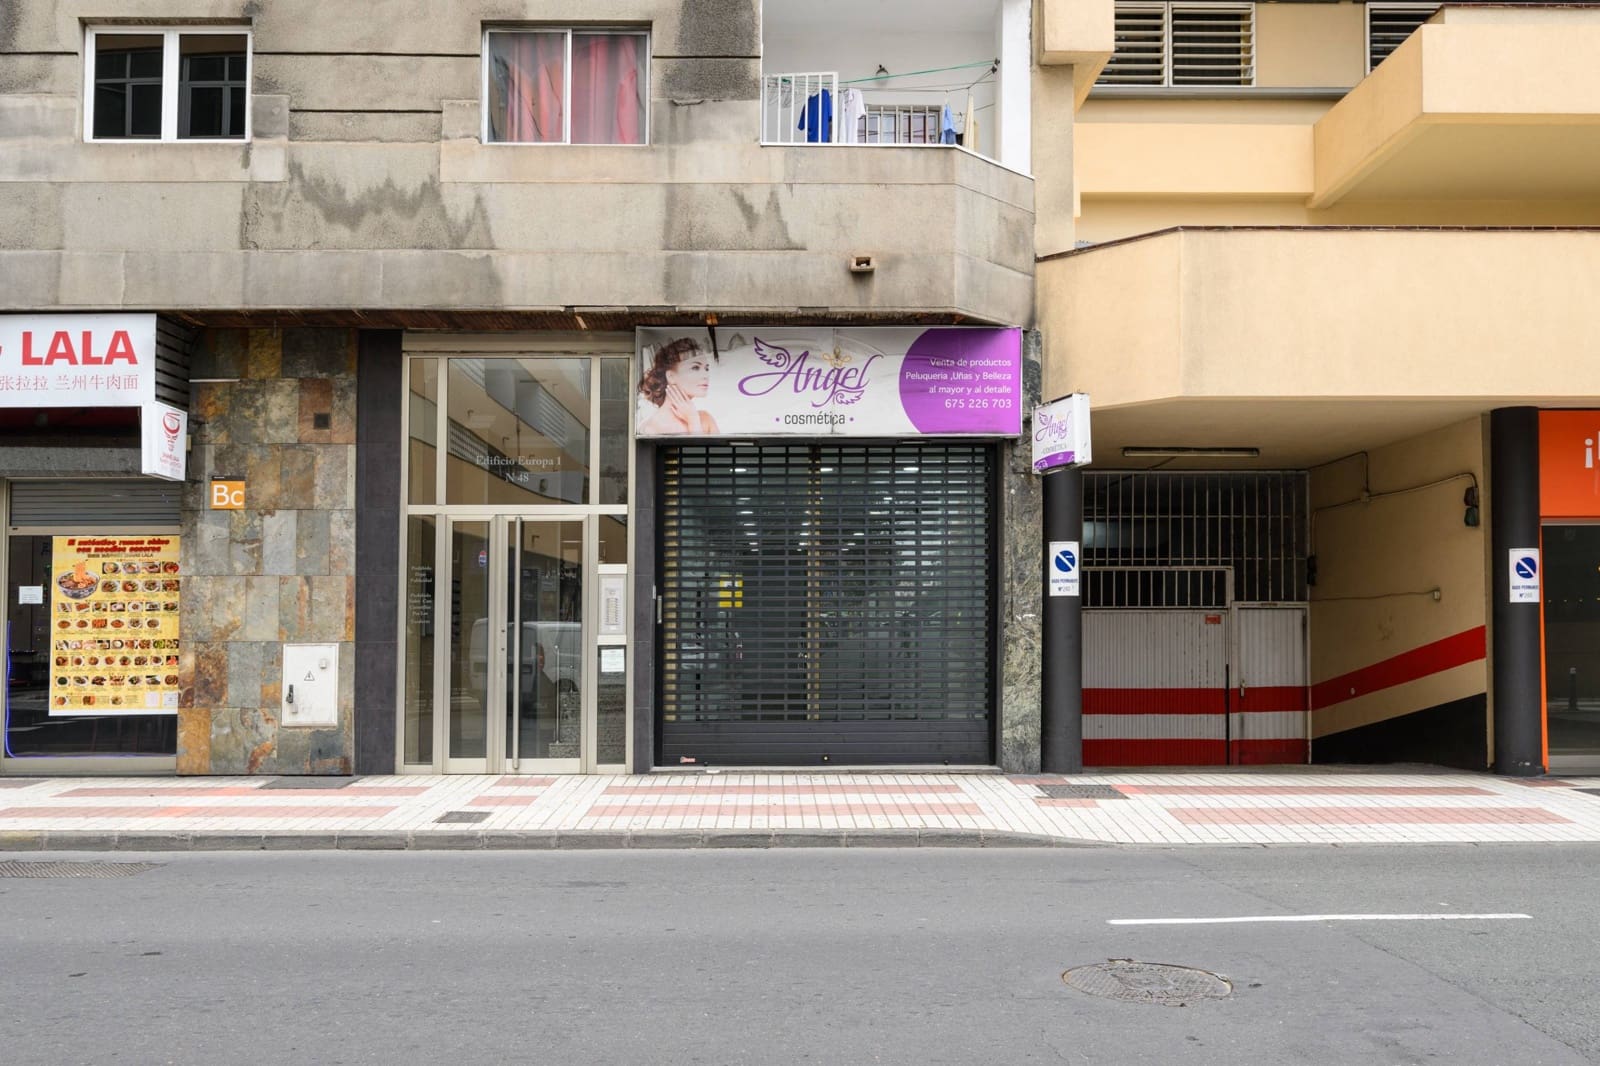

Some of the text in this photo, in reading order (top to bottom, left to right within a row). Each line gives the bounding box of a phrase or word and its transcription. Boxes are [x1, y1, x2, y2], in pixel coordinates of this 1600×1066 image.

[22, 331, 138, 365] LALA
[930, 358, 1012, 368] Venta de productos
[55, 374, 138, 391] 兰州牛肉面
[738, 350, 884, 407] Angel
[975, 373, 980, 381] y
[982, 370, 1012, 380] Belleza
[928, 385, 1012, 395] al mayor y al detalle
[945, 398, 1012, 409] 675 226 703
[784, 411, 846, 425] cosmética
[476, 455, 515, 466] Edificio
[517, 455, 554, 469] Europa
[212, 484, 243, 506] Bc
